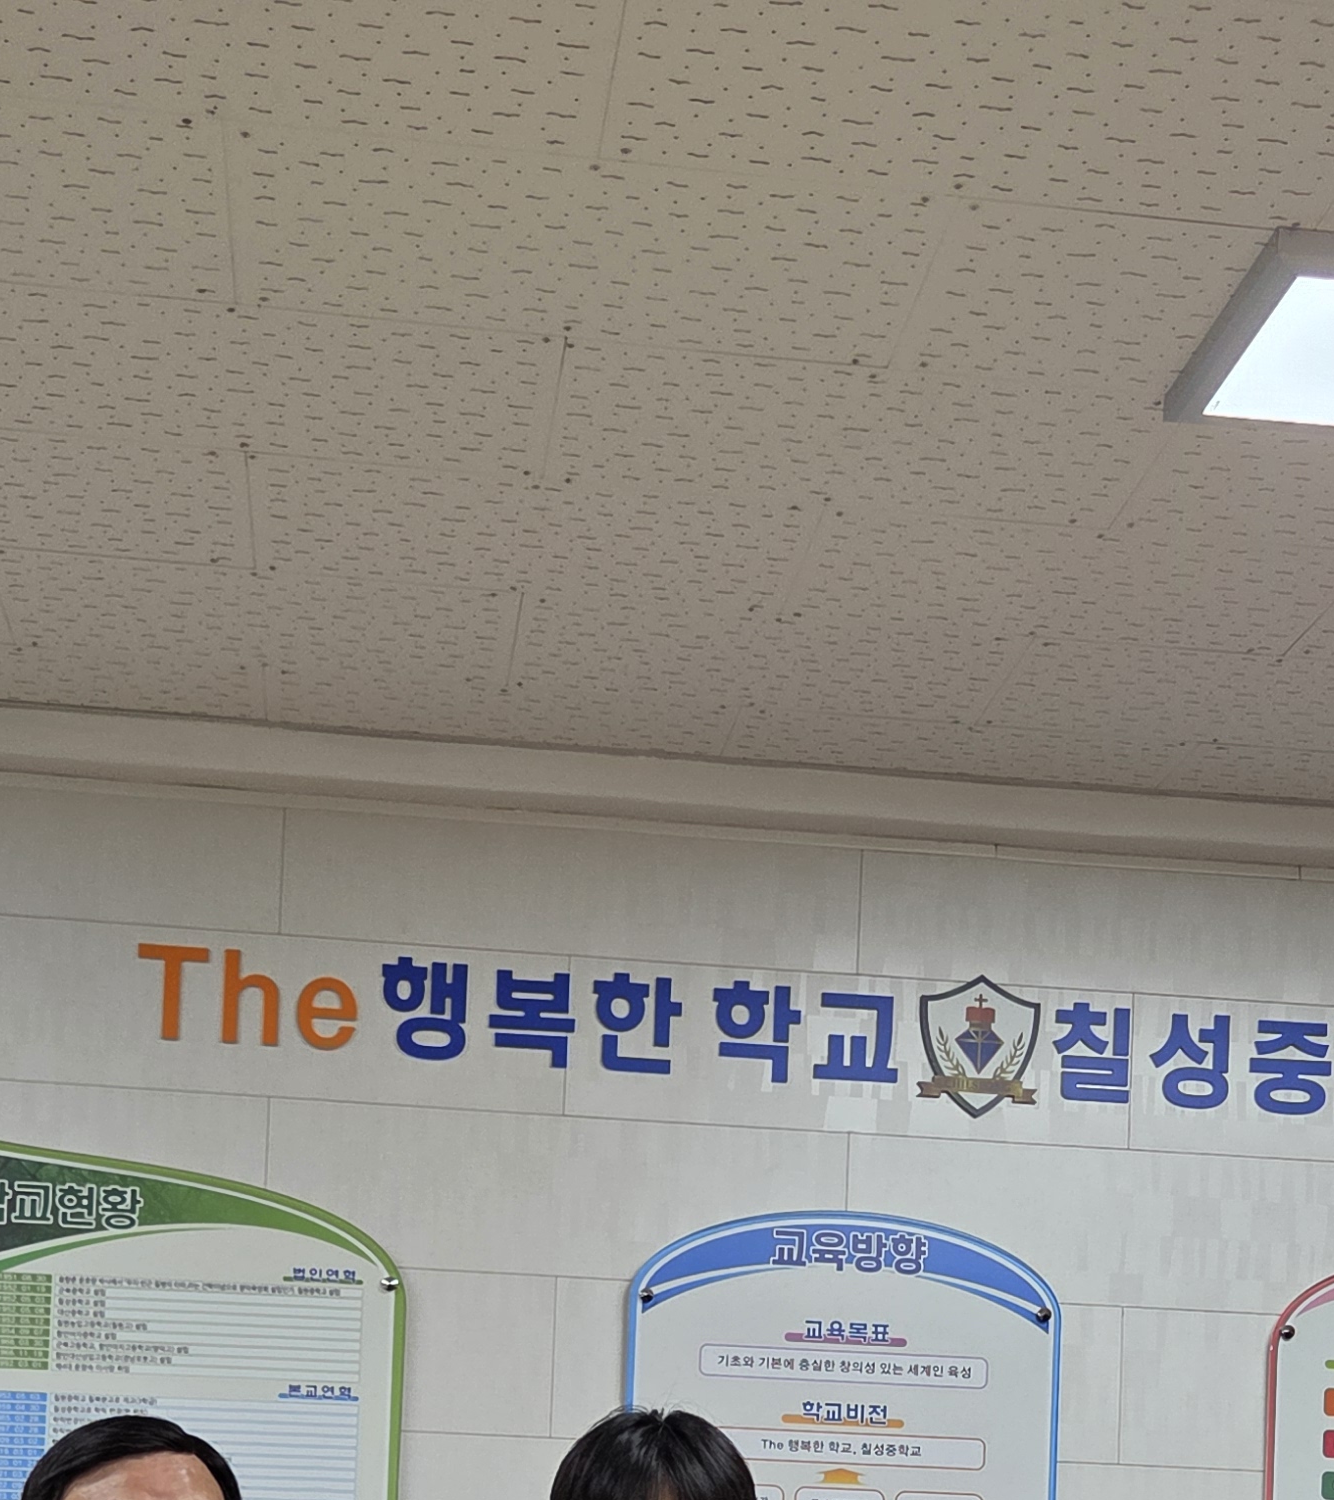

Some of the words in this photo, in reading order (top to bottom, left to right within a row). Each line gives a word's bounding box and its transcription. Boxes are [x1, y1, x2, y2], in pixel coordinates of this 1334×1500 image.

[138, 943, 358, 1051] The
[381, 954, 683, 1076] 행복한
[712, 979, 900, 1085] 학교
[770, 1228, 928, 1276] 교육방향
[803, 1320, 890, 1343] 교육목표
[718, 1355, 754, 1368] 기초와
[758, 1357, 795, 1370] 기본에
[799, 1359, 835, 1372] 충실한
[839, 1360, 875, 1374] 창의성
[880, 1363, 902, 1375] 있는
[907, 1364, 944, 1377] 세계인
[948, 1366, 972, 1378] 육성
[802, 1401, 888, 1424] 학교비전
[761, 1439, 784, 1450] The
[788, 1439, 824, 1453] 행복한
[861, 1442, 921, 1457] 칠성중학교
